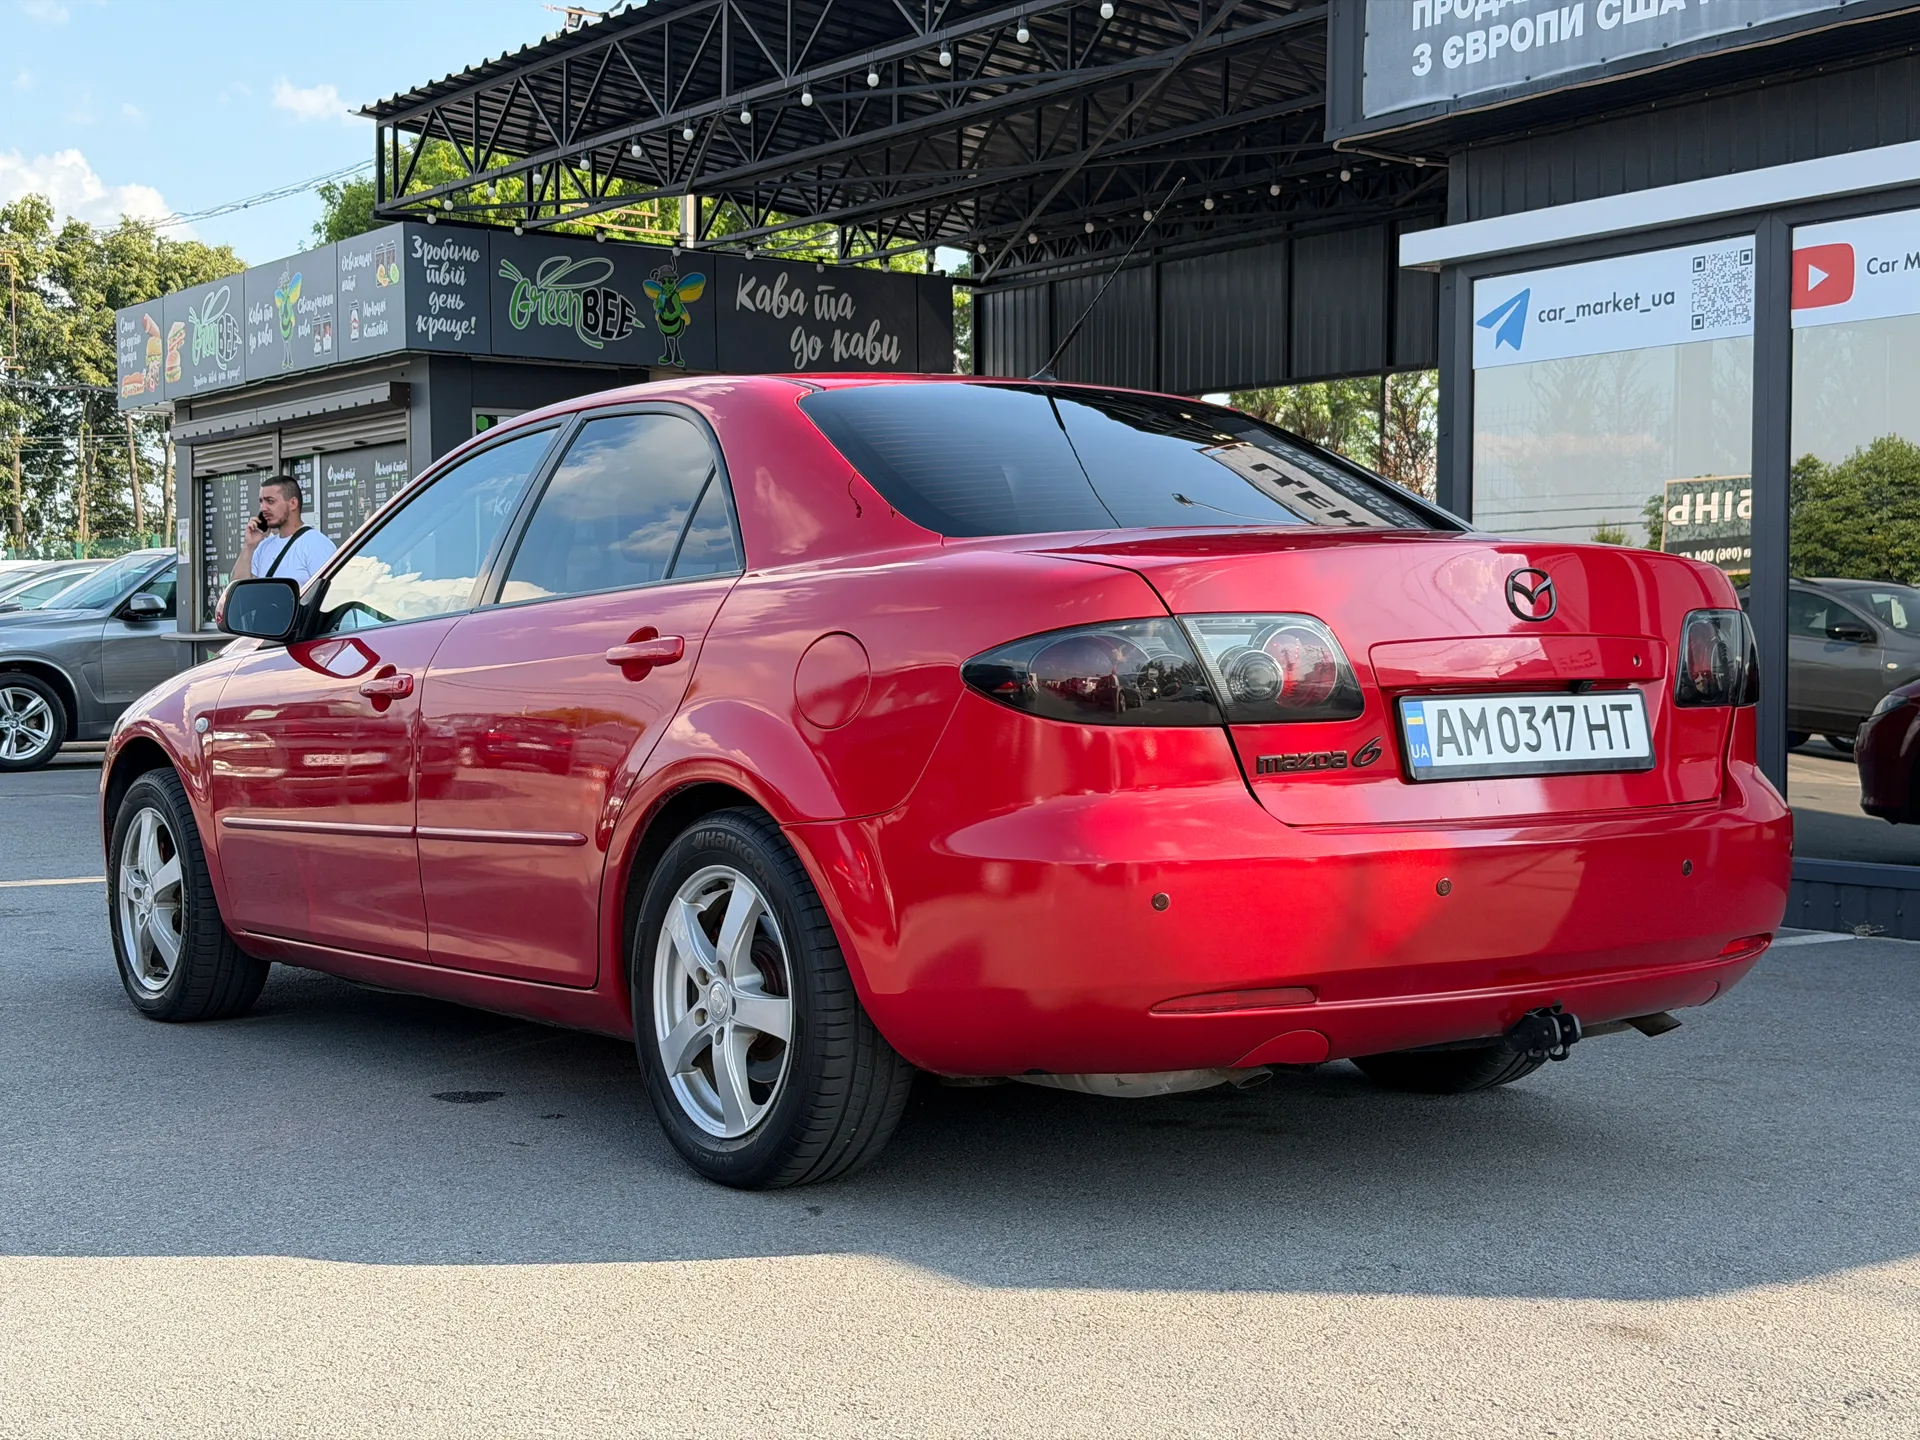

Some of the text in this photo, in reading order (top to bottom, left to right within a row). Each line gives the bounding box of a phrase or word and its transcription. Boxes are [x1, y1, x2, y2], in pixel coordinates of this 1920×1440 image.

[1412, 43, 1432, 77] З
[1442, 3, 1584, 69] ЄВРОПИ
[411, 235, 480, 267] Зробимо
[1866, 256, 1899, 275] Car
[426, 261, 467, 286] твій
[428, 291, 465, 315] день
[509, 277, 637, 349] GreenBEE
[736, 271, 856, 322] Кава та
[1537, 290, 1676, 324] car_market_ua
[416, 315, 476, 341] краще!
[790, 319, 902, 370] до кави
[1436, 703, 1634, 758] AM 0317 HT
[1351, 735, 1384, 768] 6
[1411, 743, 1430, 759] UA
